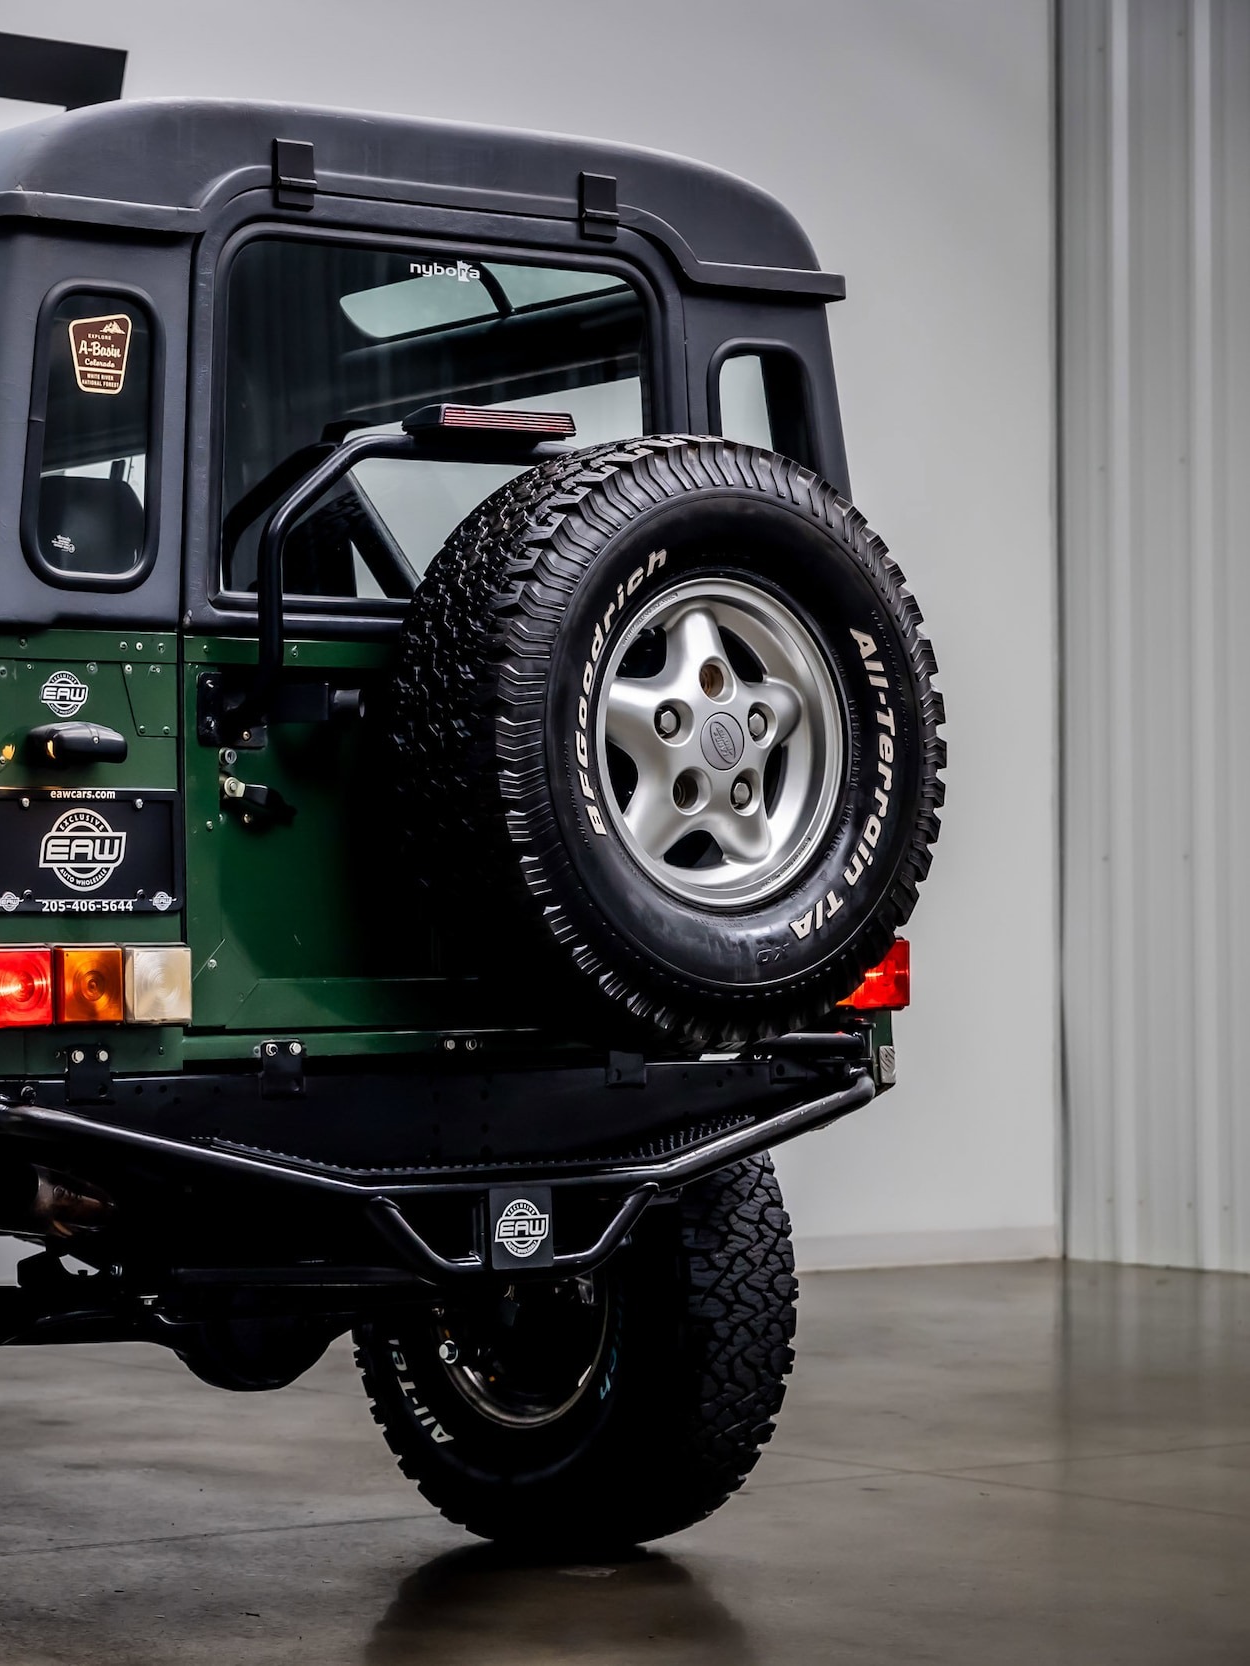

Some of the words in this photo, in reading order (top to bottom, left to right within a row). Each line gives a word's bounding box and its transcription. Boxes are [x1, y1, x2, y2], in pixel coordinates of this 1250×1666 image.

[78, 340, 121, 357] A-Basin
[84, 358, 115, 368] Colorado
[43, 686, 86, 701] EAW
[573, 548, 667, 837] BFGoodrich
[843, 627, 896, 887] All-Terrain
[50, 789, 116, 800] eawcars.com
[59, 813, 105, 832] EXCLUSIVE
[45, 838, 121, 861] EAW
[59, 868, 75, 883] AUTO
[75, 868, 108, 887] WHOLESALE
[41, 900, 134, 912] 205-406-5644
[789, 890, 844, 940] T/A
[499, 1219, 546, 1237] EAW
